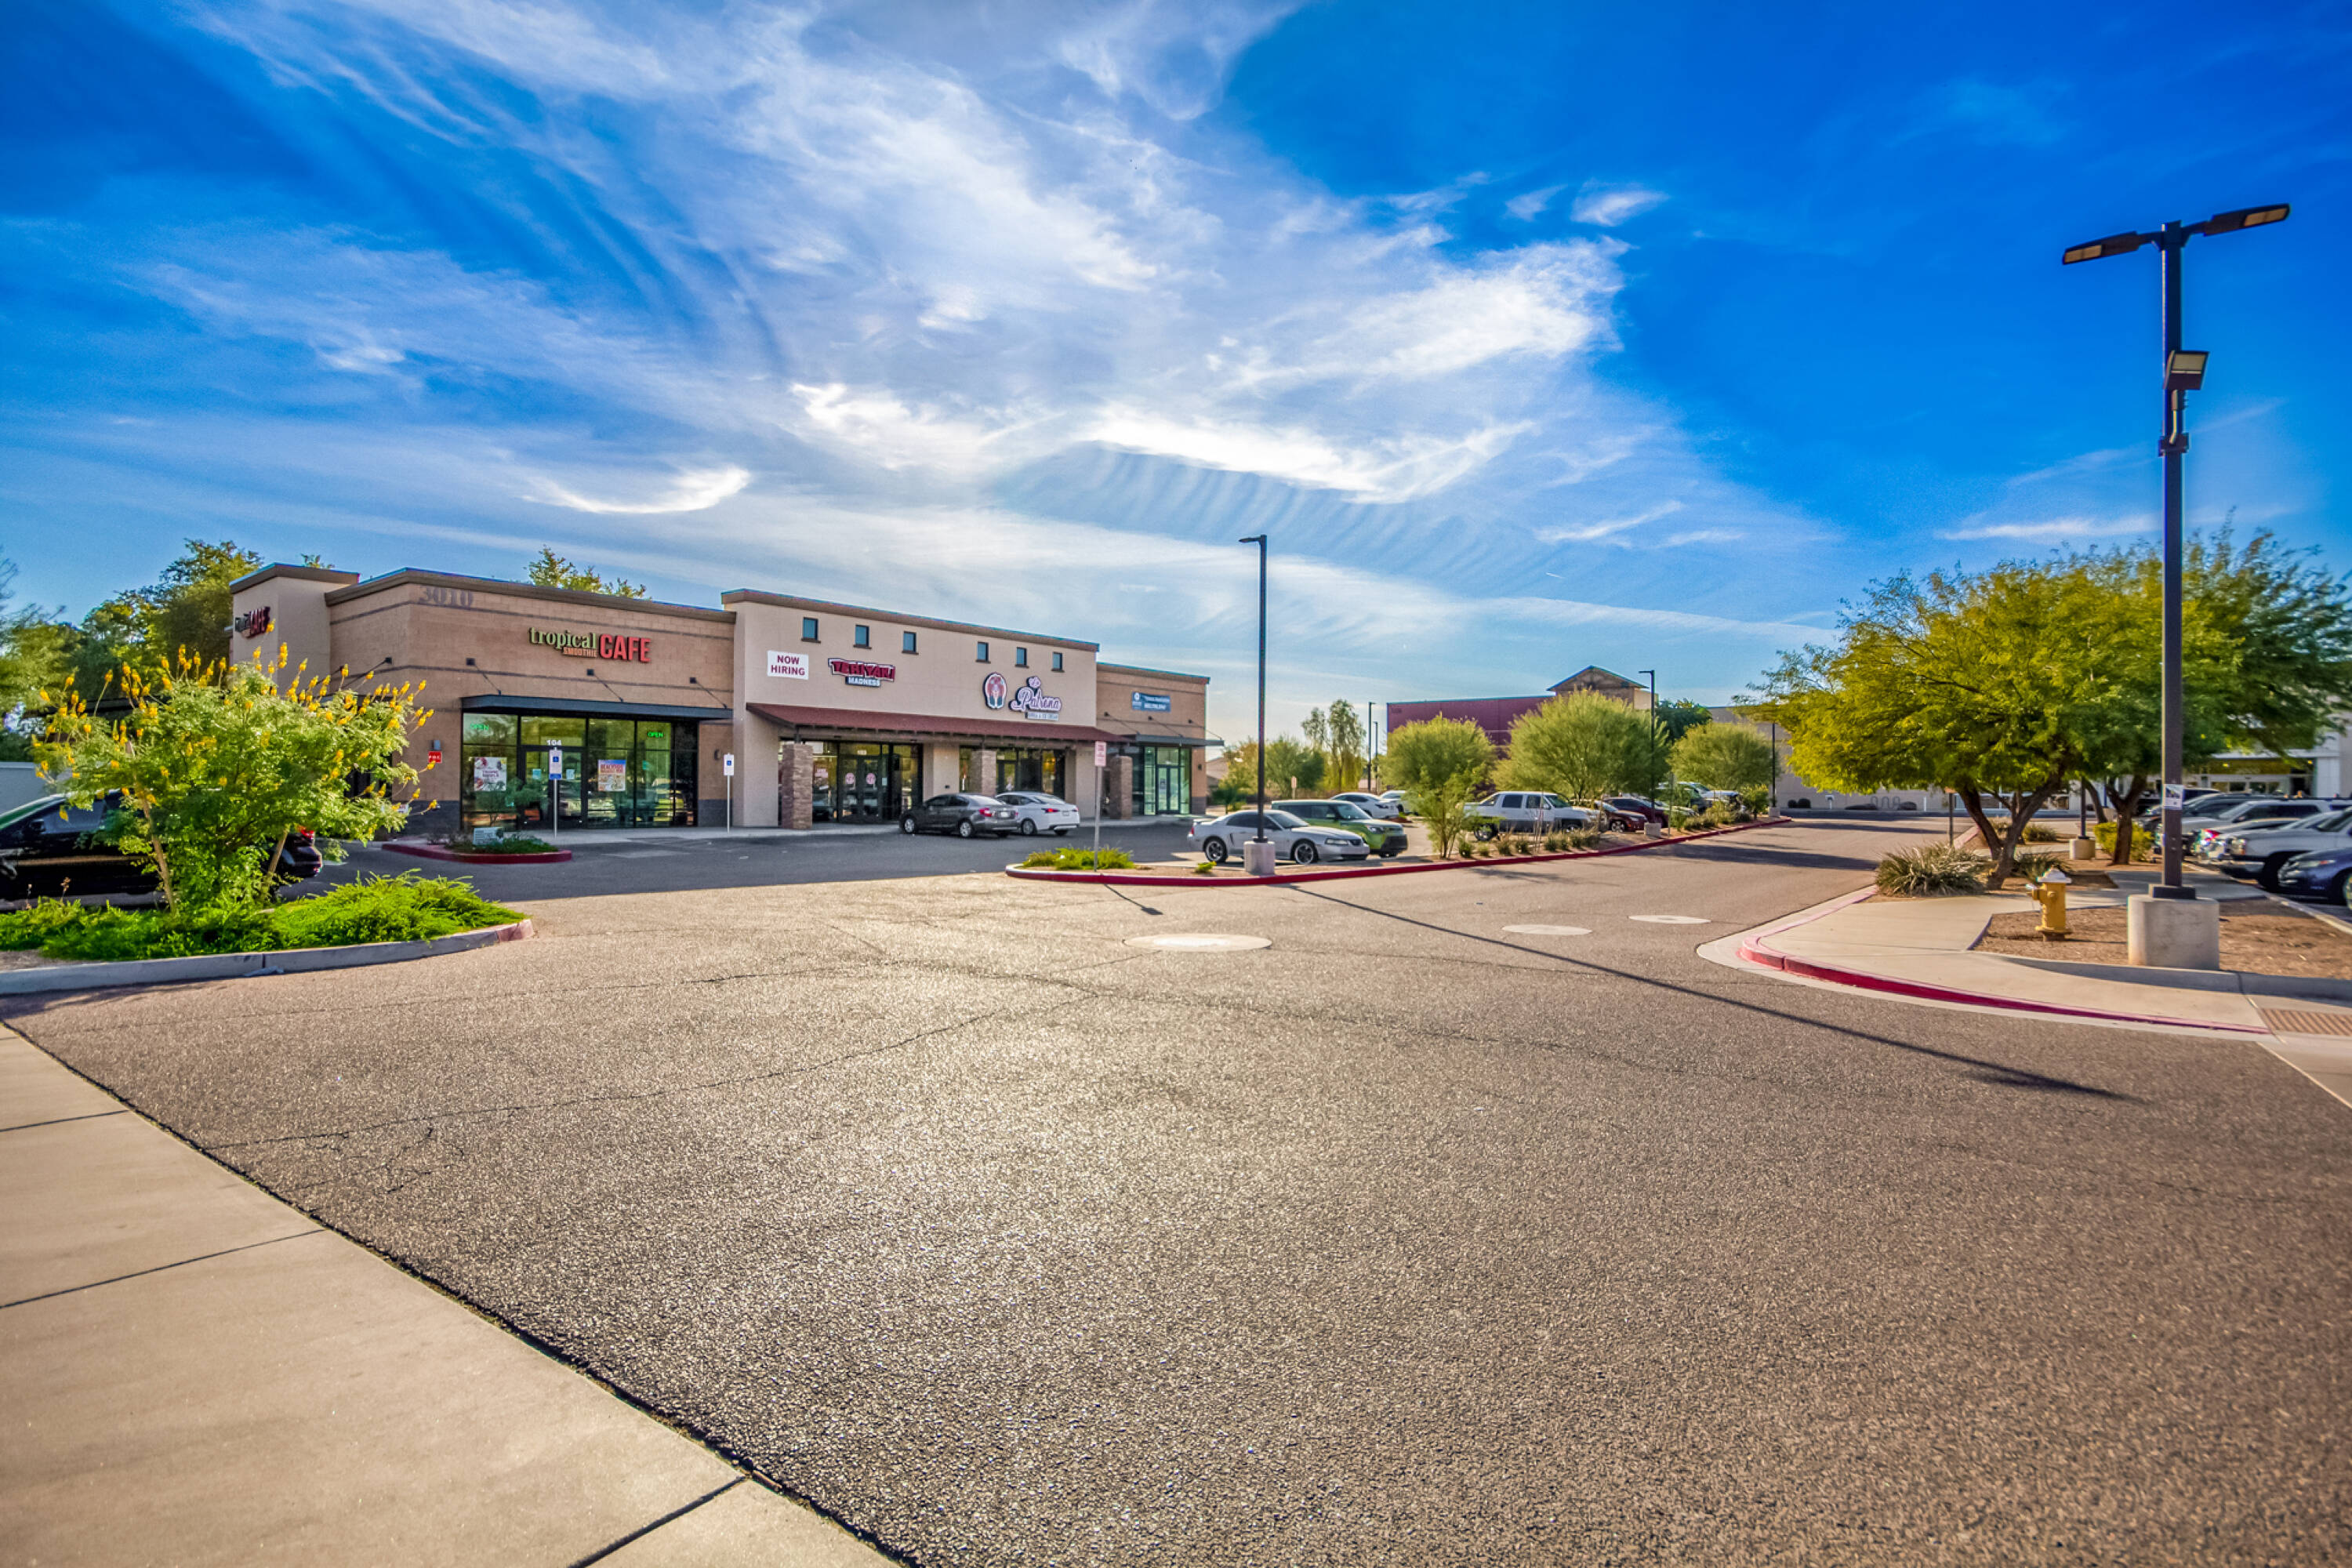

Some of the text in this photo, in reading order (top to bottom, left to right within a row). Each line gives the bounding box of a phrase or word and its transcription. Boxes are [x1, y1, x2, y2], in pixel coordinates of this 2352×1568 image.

[418, 586, 474, 607] 3010
[529, 626, 597, 650] tropical
[562, 646, 597, 658] SMOOTHIE
[599, 633, 652, 662] CAFE
[777, 655, 800, 665] NOW
[771, 665, 806, 676] HIRING
[831, 661, 895, 680] TERIYAKI
[848, 676, 880, 686] MADNESS
